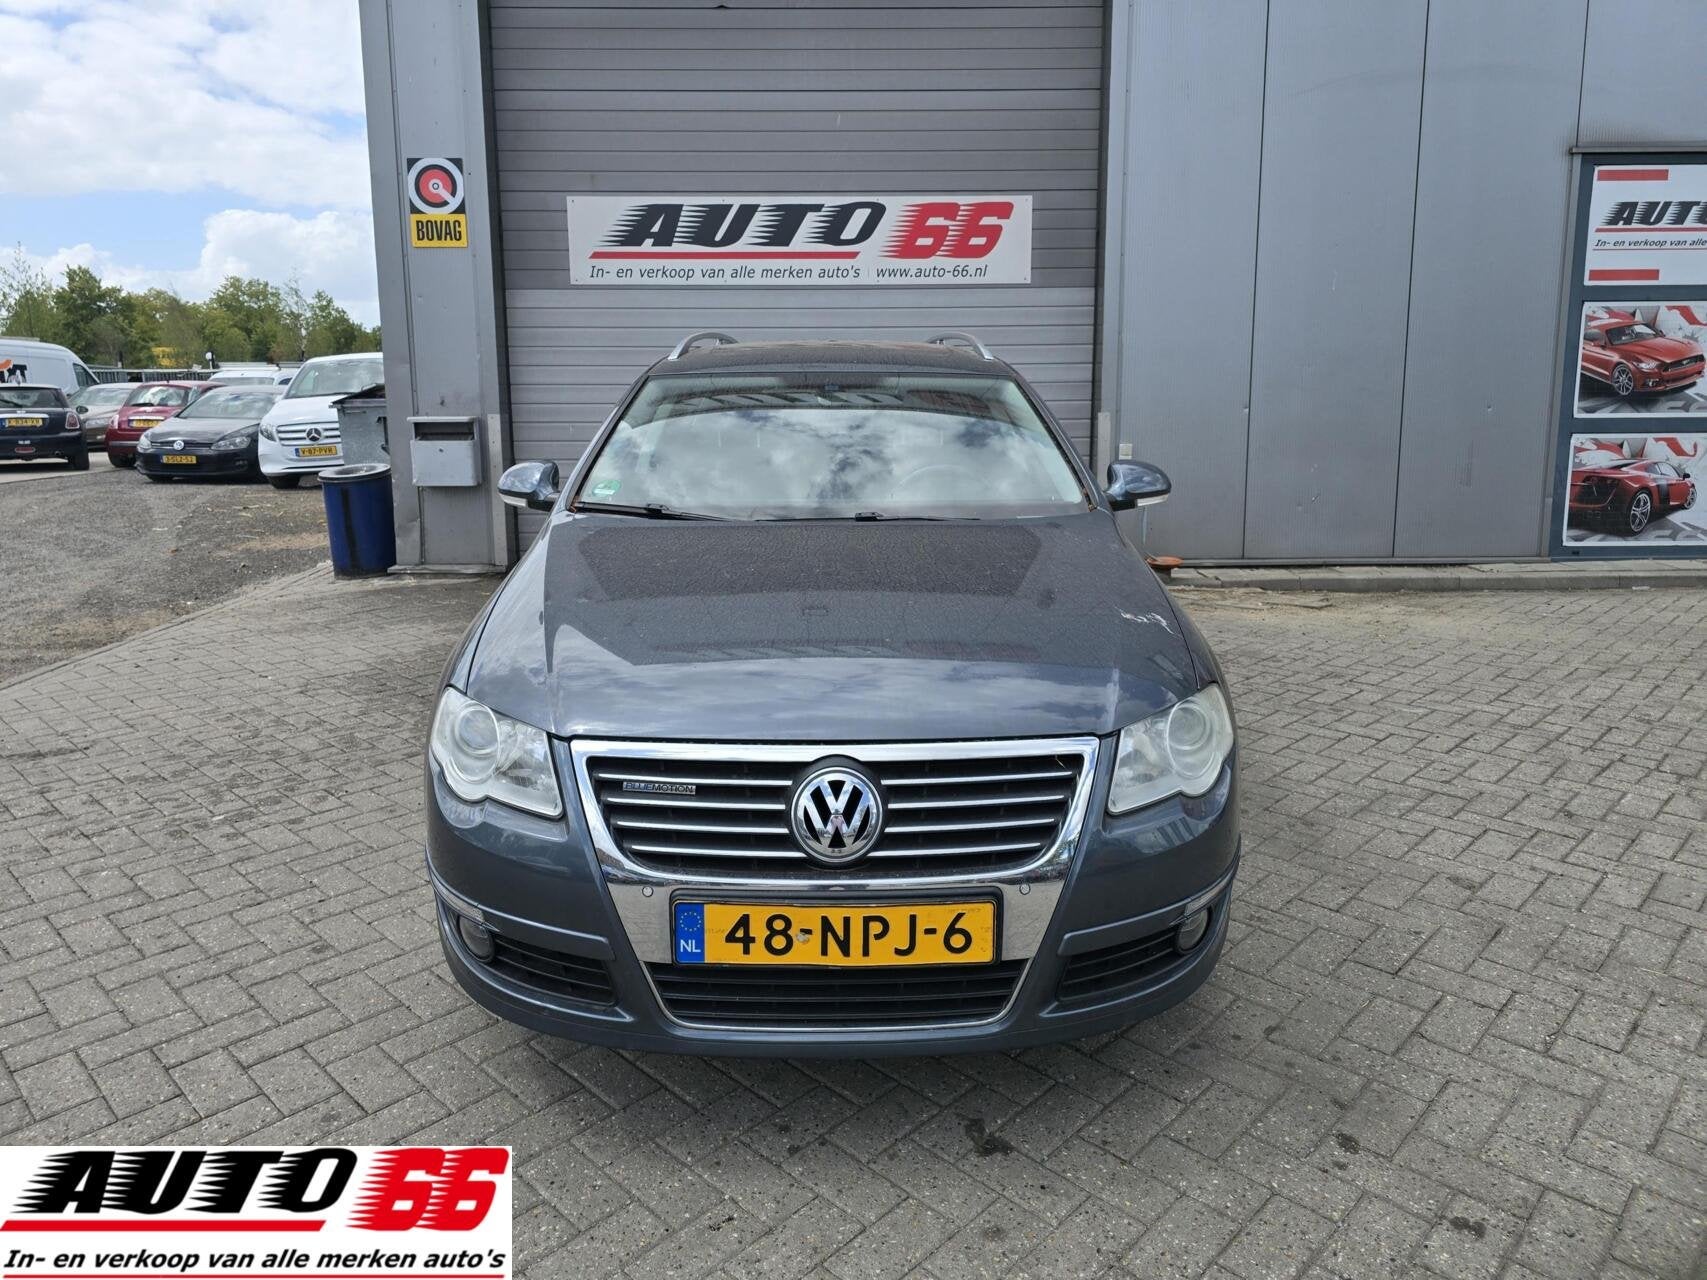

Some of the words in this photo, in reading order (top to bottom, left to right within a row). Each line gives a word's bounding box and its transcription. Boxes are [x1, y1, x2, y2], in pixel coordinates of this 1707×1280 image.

[416, 220, 462, 242] BOVAG
[597, 201, 887, 248] AUTO
[877, 201, 1015, 259] 66
[1594, 239, 1611, 248] In-
[1628, 239, 1667, 248] verkoop
[589, 265, 611, 279] In-
[616, 268, 633, 279] en
[639, 265, 695, 281] verkoop
[701, 267, 725, 279] van
[730, 265, 756, 279] alle
[760, 266, 813, 279] merken
[818, 265, 861, 279] auto's
[876, 264, 988, 279] www.auto-66.nl
[624, 783, 694, 794] BLUEMOTION
[724, 912, 973, 958] 48-NPJ-6
[680, 939, 701, 953] NL
